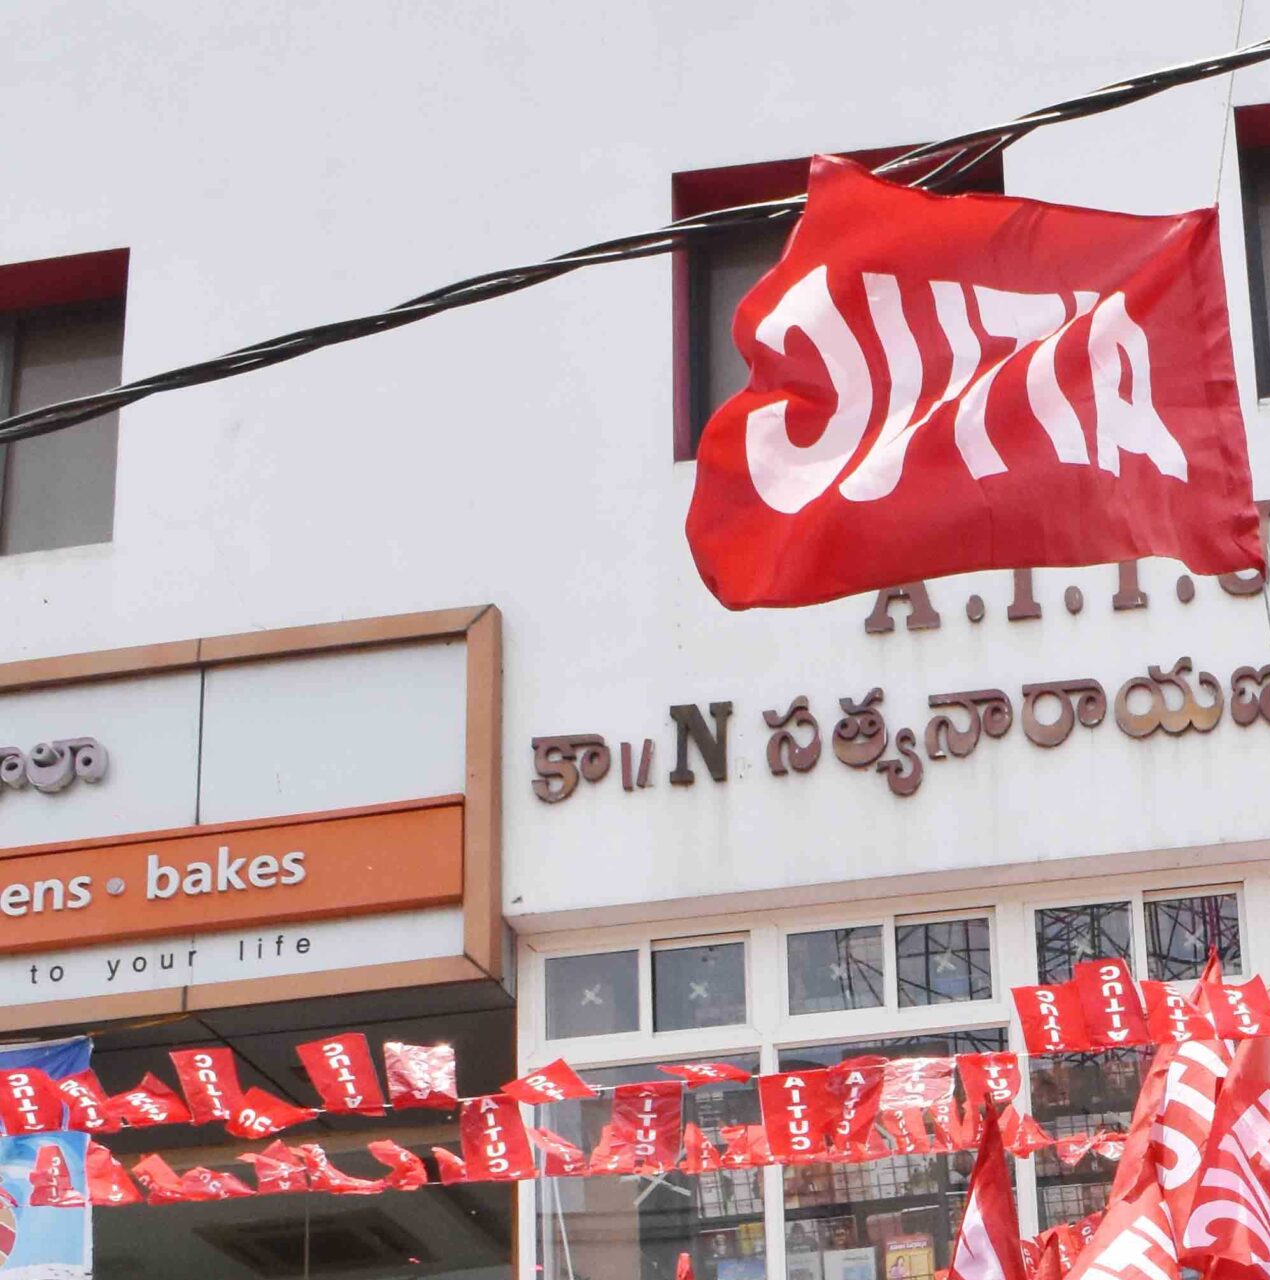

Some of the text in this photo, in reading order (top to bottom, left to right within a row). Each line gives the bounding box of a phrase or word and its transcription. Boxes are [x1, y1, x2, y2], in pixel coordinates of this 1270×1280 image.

[669, 701, 732, 784] N
[146, 846, 307, 901] bakes
[30, 934, 311, 984] to your life
[1099, 965, 1130, 1042] AITUC
[322, 1042, 364, 1109] AITUC
